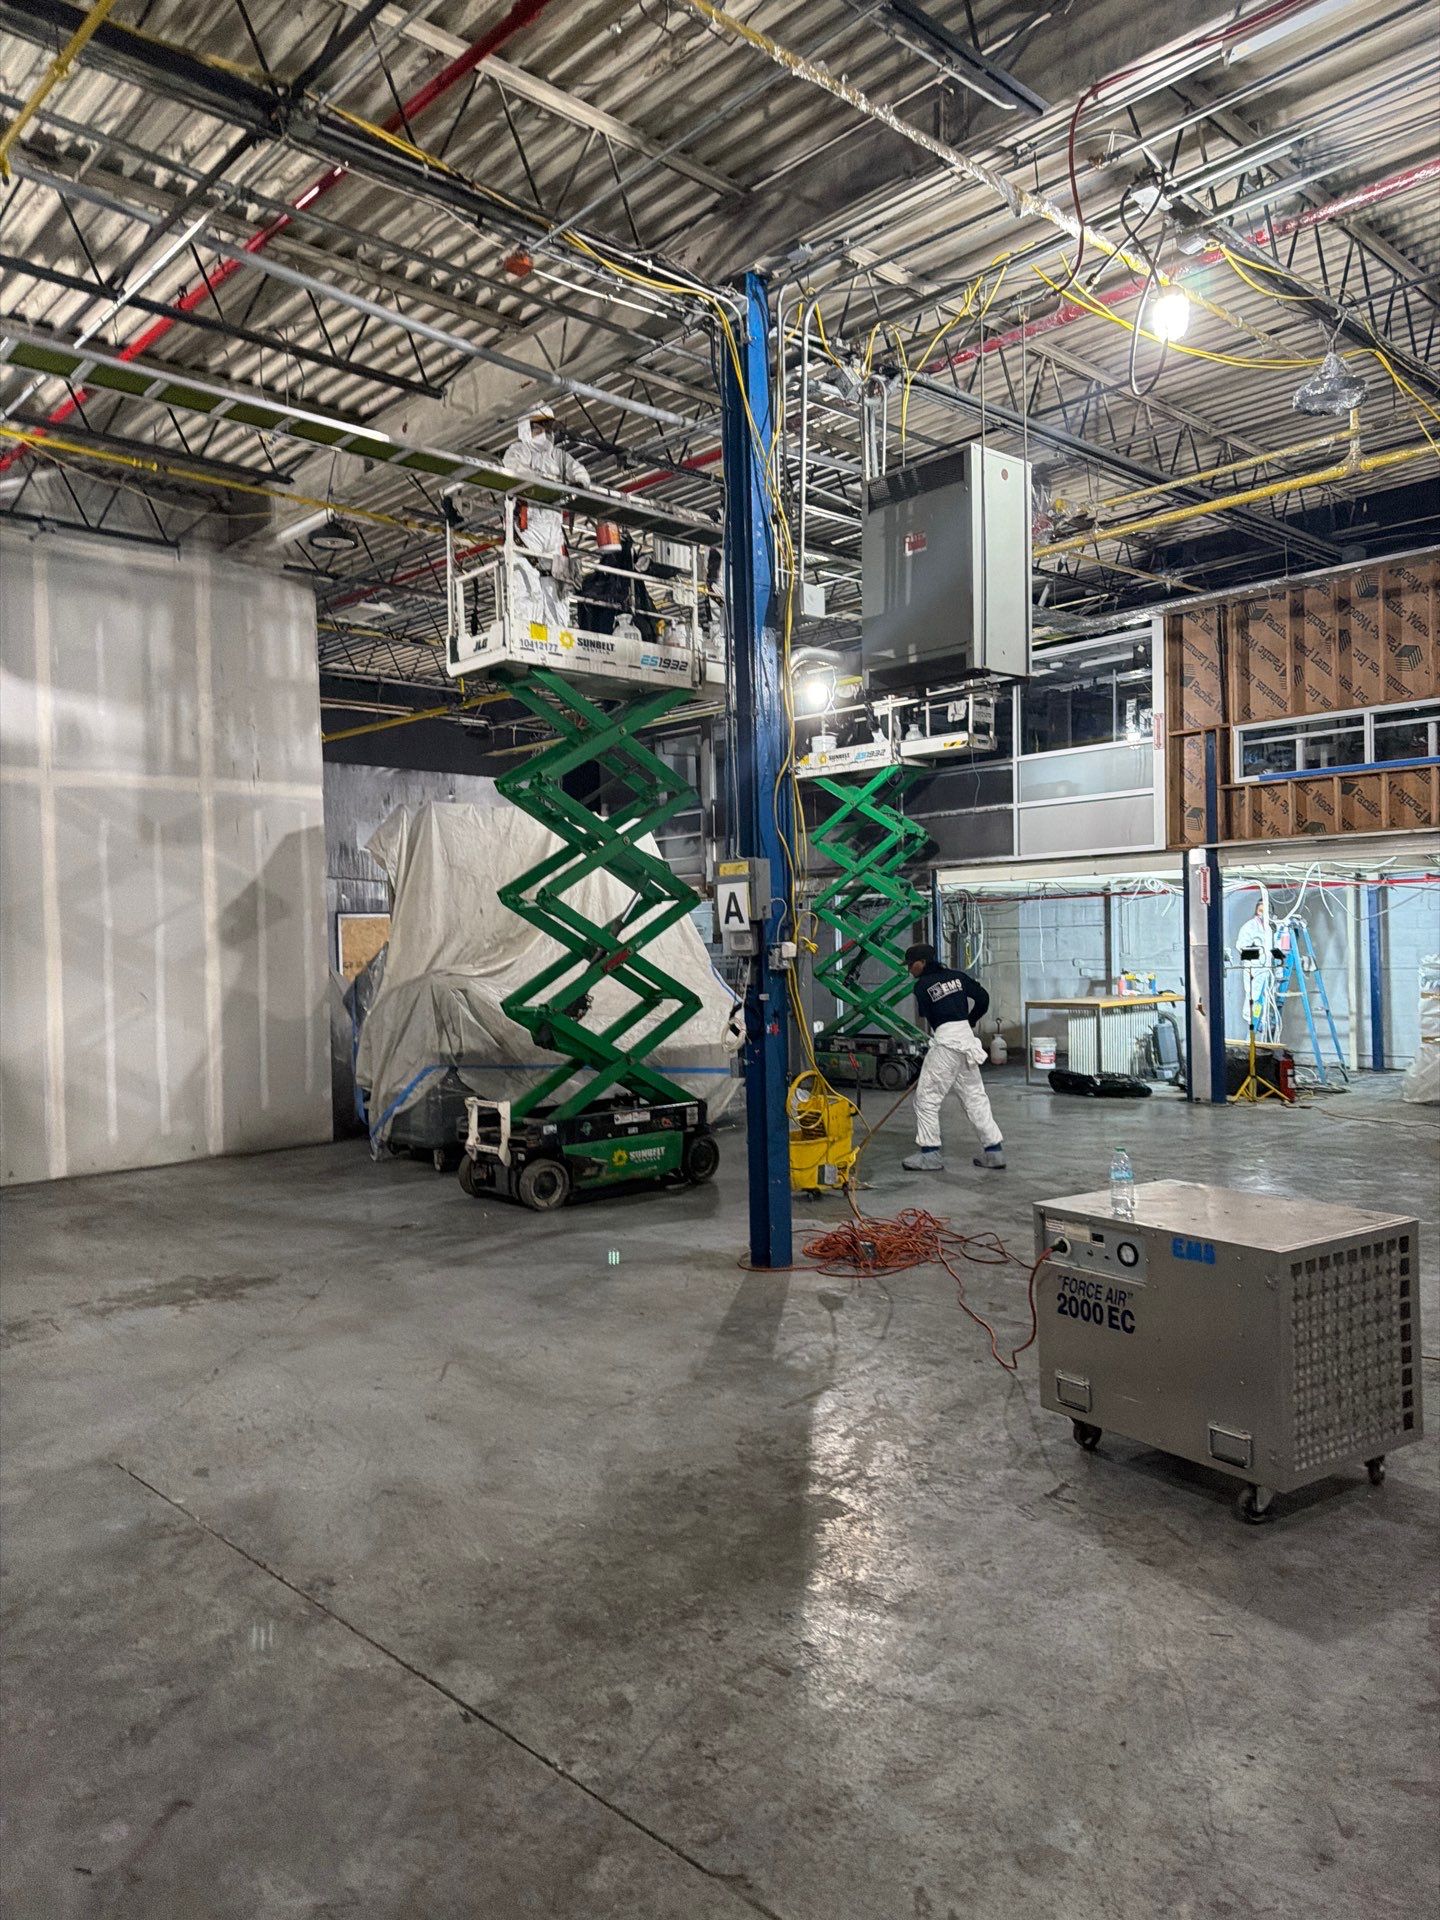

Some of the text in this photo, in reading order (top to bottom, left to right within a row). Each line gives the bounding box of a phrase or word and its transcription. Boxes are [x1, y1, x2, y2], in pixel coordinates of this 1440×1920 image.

[577, 636, 615, 652] SUNBELT
[640, 654, 689, 672] ES1932
[1258, 645, 1285, 673] Pacific
[1395, 788, 1426, 820] Pacific
[724, 890, 745, 925] A
[941, 978, 962, 992] EMS
[1171, 1237, 1217, 1266] EMS
[1056, 1292, 1136, 1335] 2000 EC
